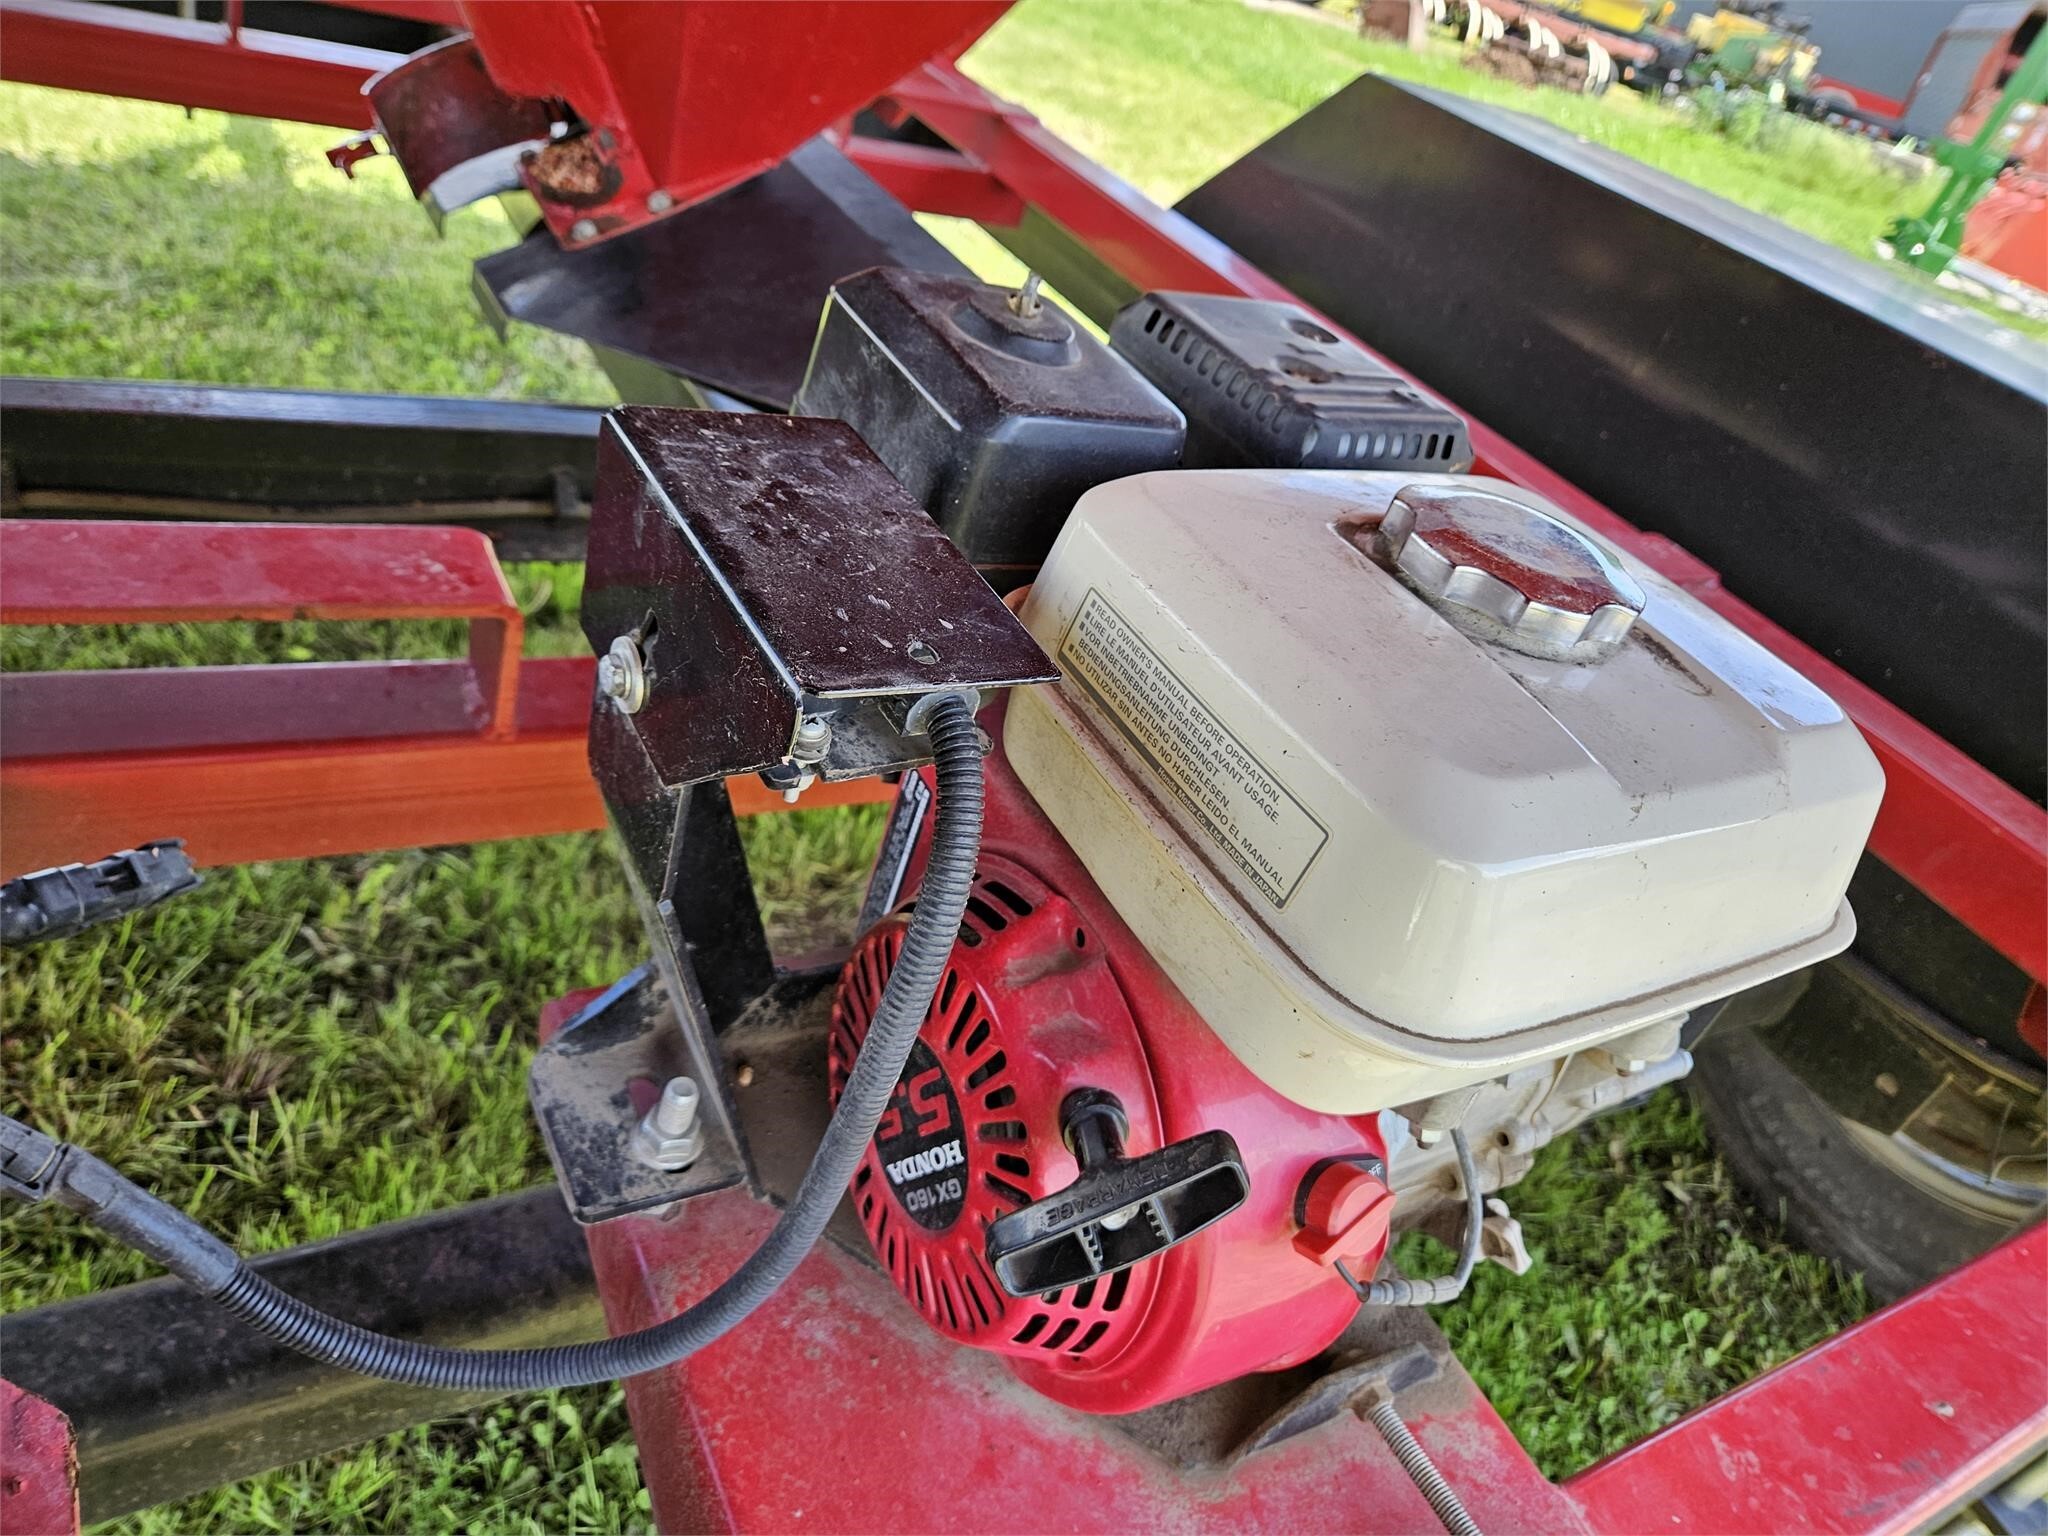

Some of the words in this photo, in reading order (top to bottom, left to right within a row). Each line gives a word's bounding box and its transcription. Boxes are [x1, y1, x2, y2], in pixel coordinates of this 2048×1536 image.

[1073, 648, 1086, 665] NO
[1085, 664, 1118, 703] UTILIZAR
[1117, 700, 1134, 725] SIN
[1131, 716, 1158, 748] ANTES
[1158, 745, 1172, 763] NO
[1172, 761, 1202, 797] HABER
[1201, 794, 1228, 825] LEIDO
[1229, 824, 1241, 840] EL
[1241, 838, 1284, 891] MANUAL.
[1078, 638, 1171, 744] BEDIENUNGSANLEITUNG
[1170, 741, 1229, 810] DURCHLESEN.
[1085, 627, 1101, 649] VOR
[1100, 645, 1168, 723] INBETRIEBNAHME
[1168, 719, 1220, 777] UNBEDINGT
[1090, 616, 1107, 637] LIRE
[1106, 634, 1117, 648] LE
[1116, 645, 1149, 686] MANUEL
[1150, 682, 1211, 751] D'UTILISATEUR
[1211, 750, 1244, 783] AVANT
[1244, 782, 1279, 825] USAGE.
[1095, 604, 1116, 630] READ
[1116, 628, 1153, 669] OWNER'S
[1152, 666, 1189, 709] MANUAL
[1190, 706, 1225, 746] BEFORE
[1225, 744, 1279, 806] OPERATION.
[1157, 767, 1178, 793] Honda
[1176, 790, 1197, 813] Motor
[1222, 840, 1247, 868] MADE
[1244, 864, 1256, 877] IN
[1254, 875, 1278, 904] JAPAN
[886, 1140, 965, 1185] HONDA
